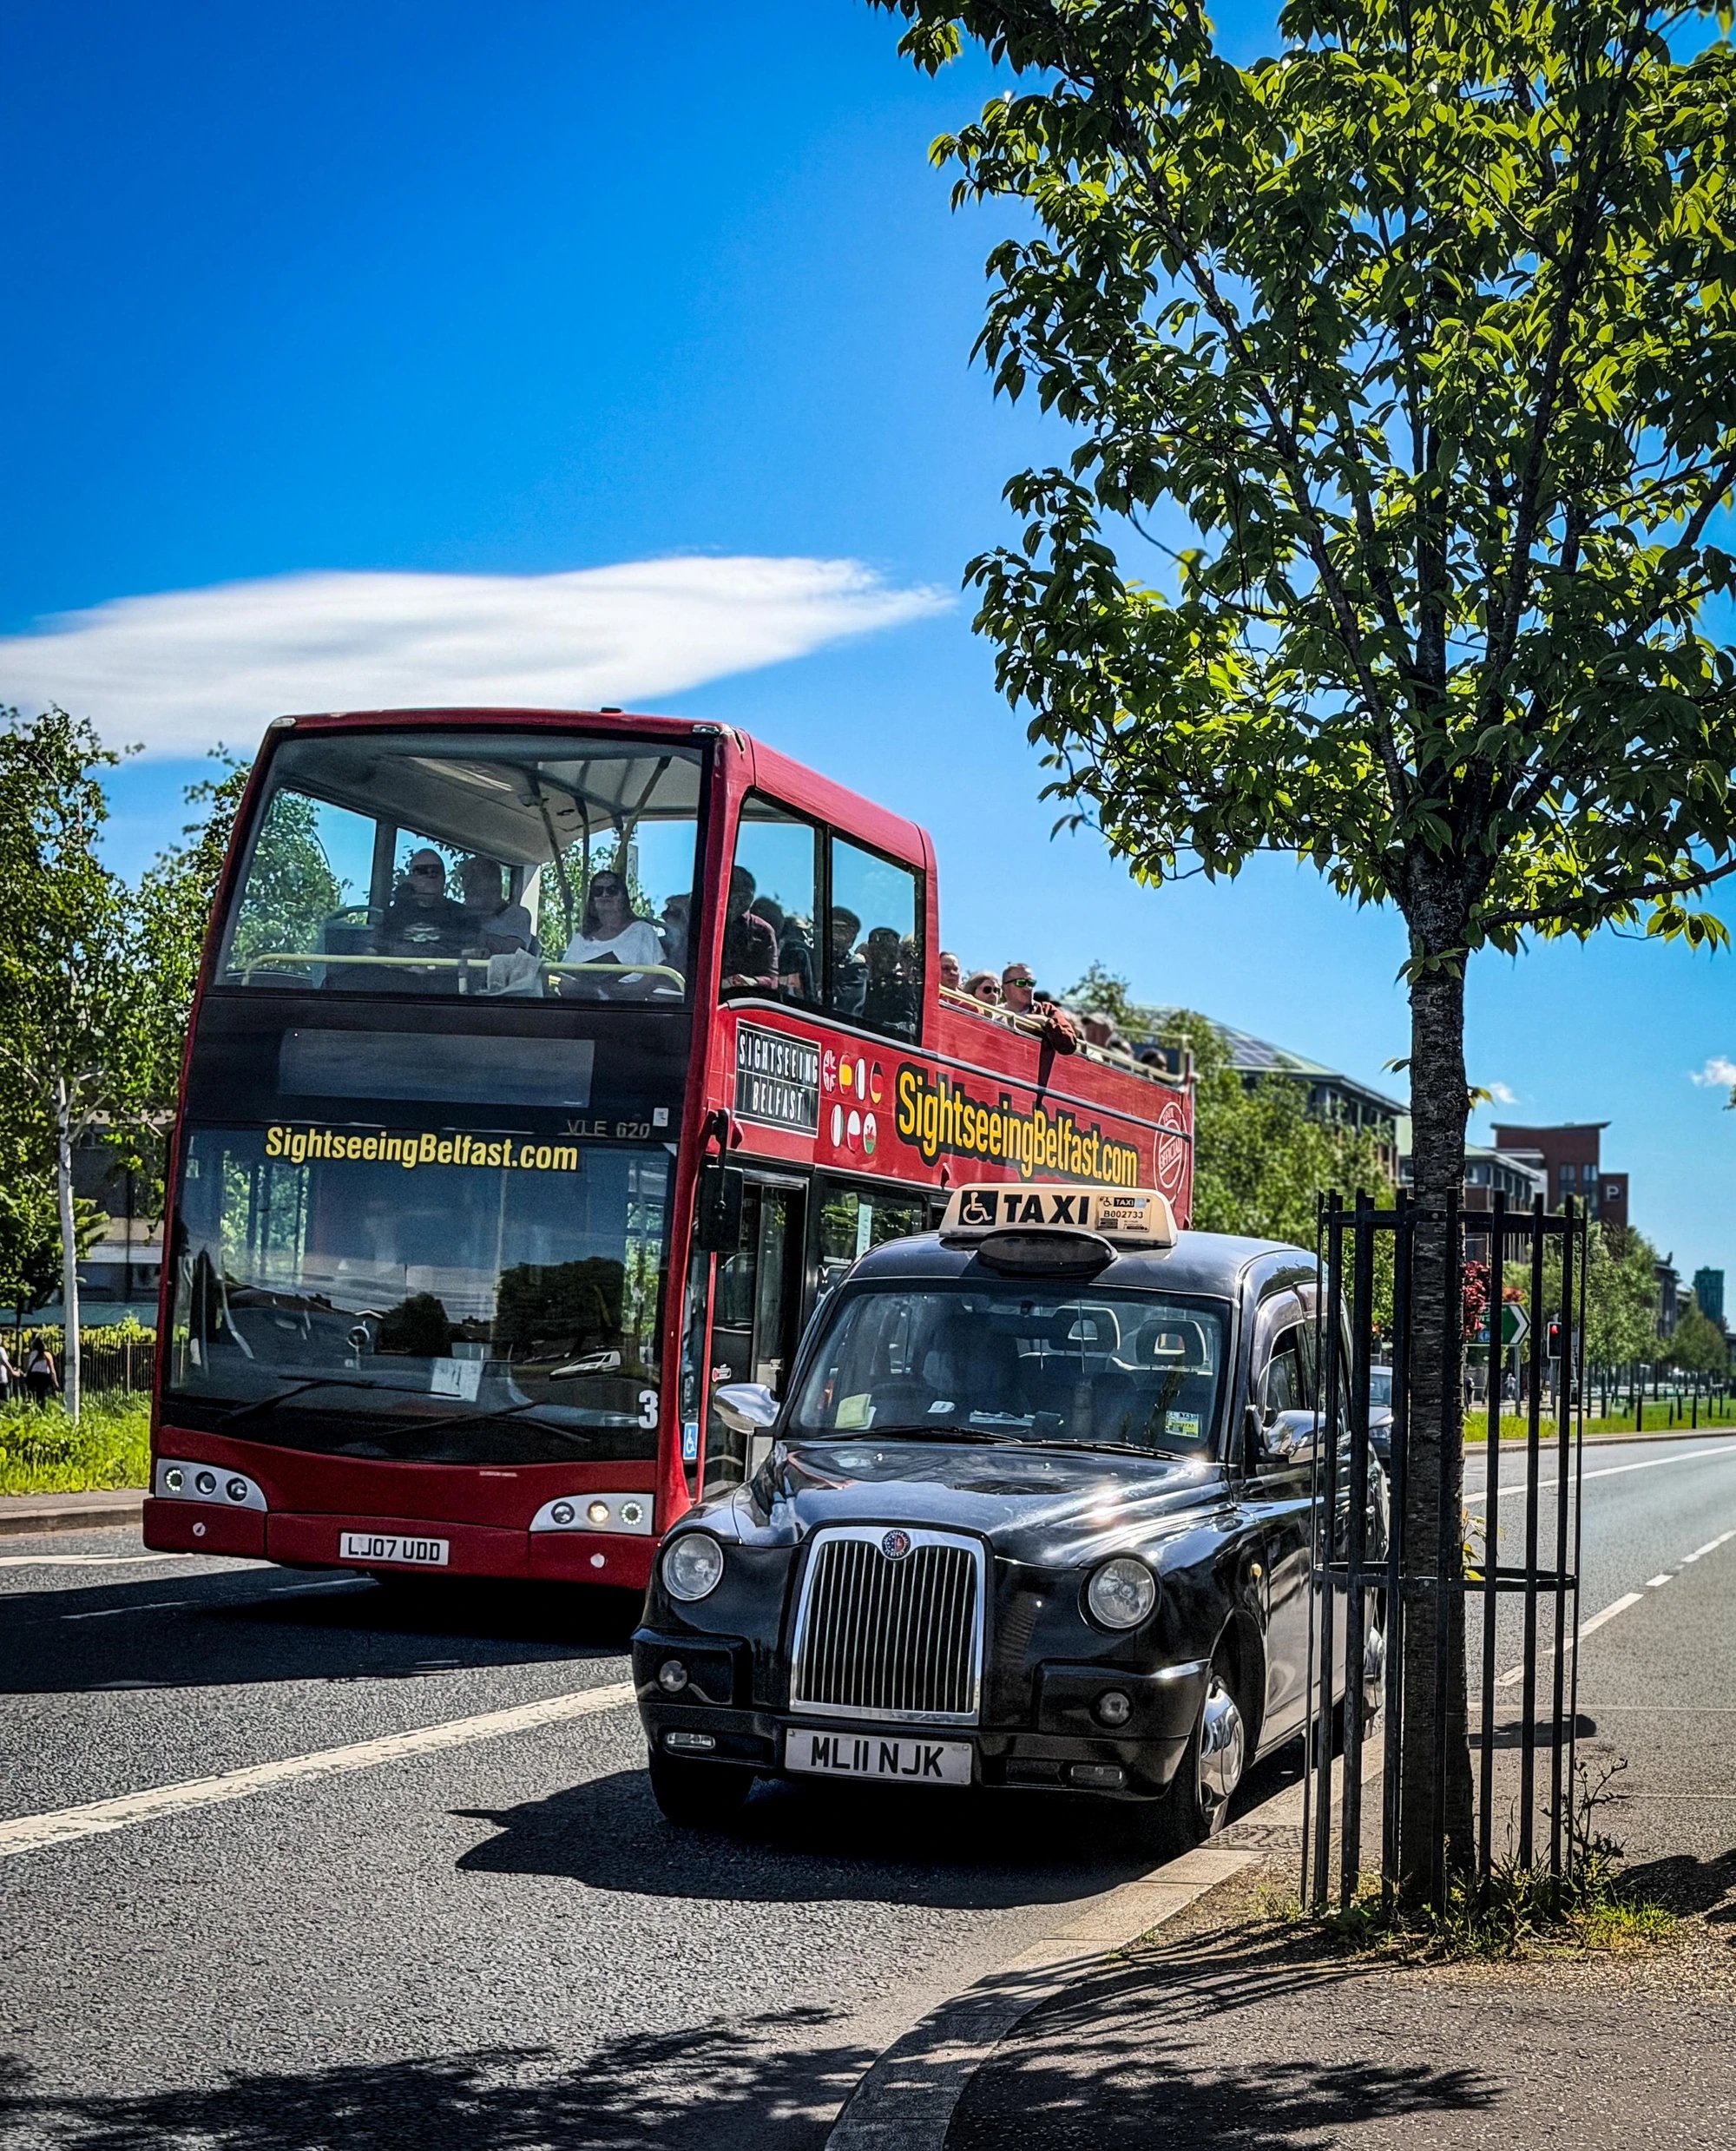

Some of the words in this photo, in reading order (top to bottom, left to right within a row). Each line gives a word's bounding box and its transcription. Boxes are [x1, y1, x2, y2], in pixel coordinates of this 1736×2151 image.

[739, 1034, 818, 1084] SIGHTSEEING
[753, 1081, 803, 1121] BELFAST
[567, 1120, 608, 1136] VLE
[616, 1122, 650, 1139] 620
[898, 1070, 1137, 1187] SightseeingBelfast.com
[266, 1128, 577, 1170] SightseeingBelfast.com
[1003, 1194, 1089, 1225] TAXI
[1606, 1185, 1620, 1201] P
[638, 1390, 659, 1429] 3
[348, 1536, 398, 1558] LJ07
[878, 1741, 944, 1778] NJK
